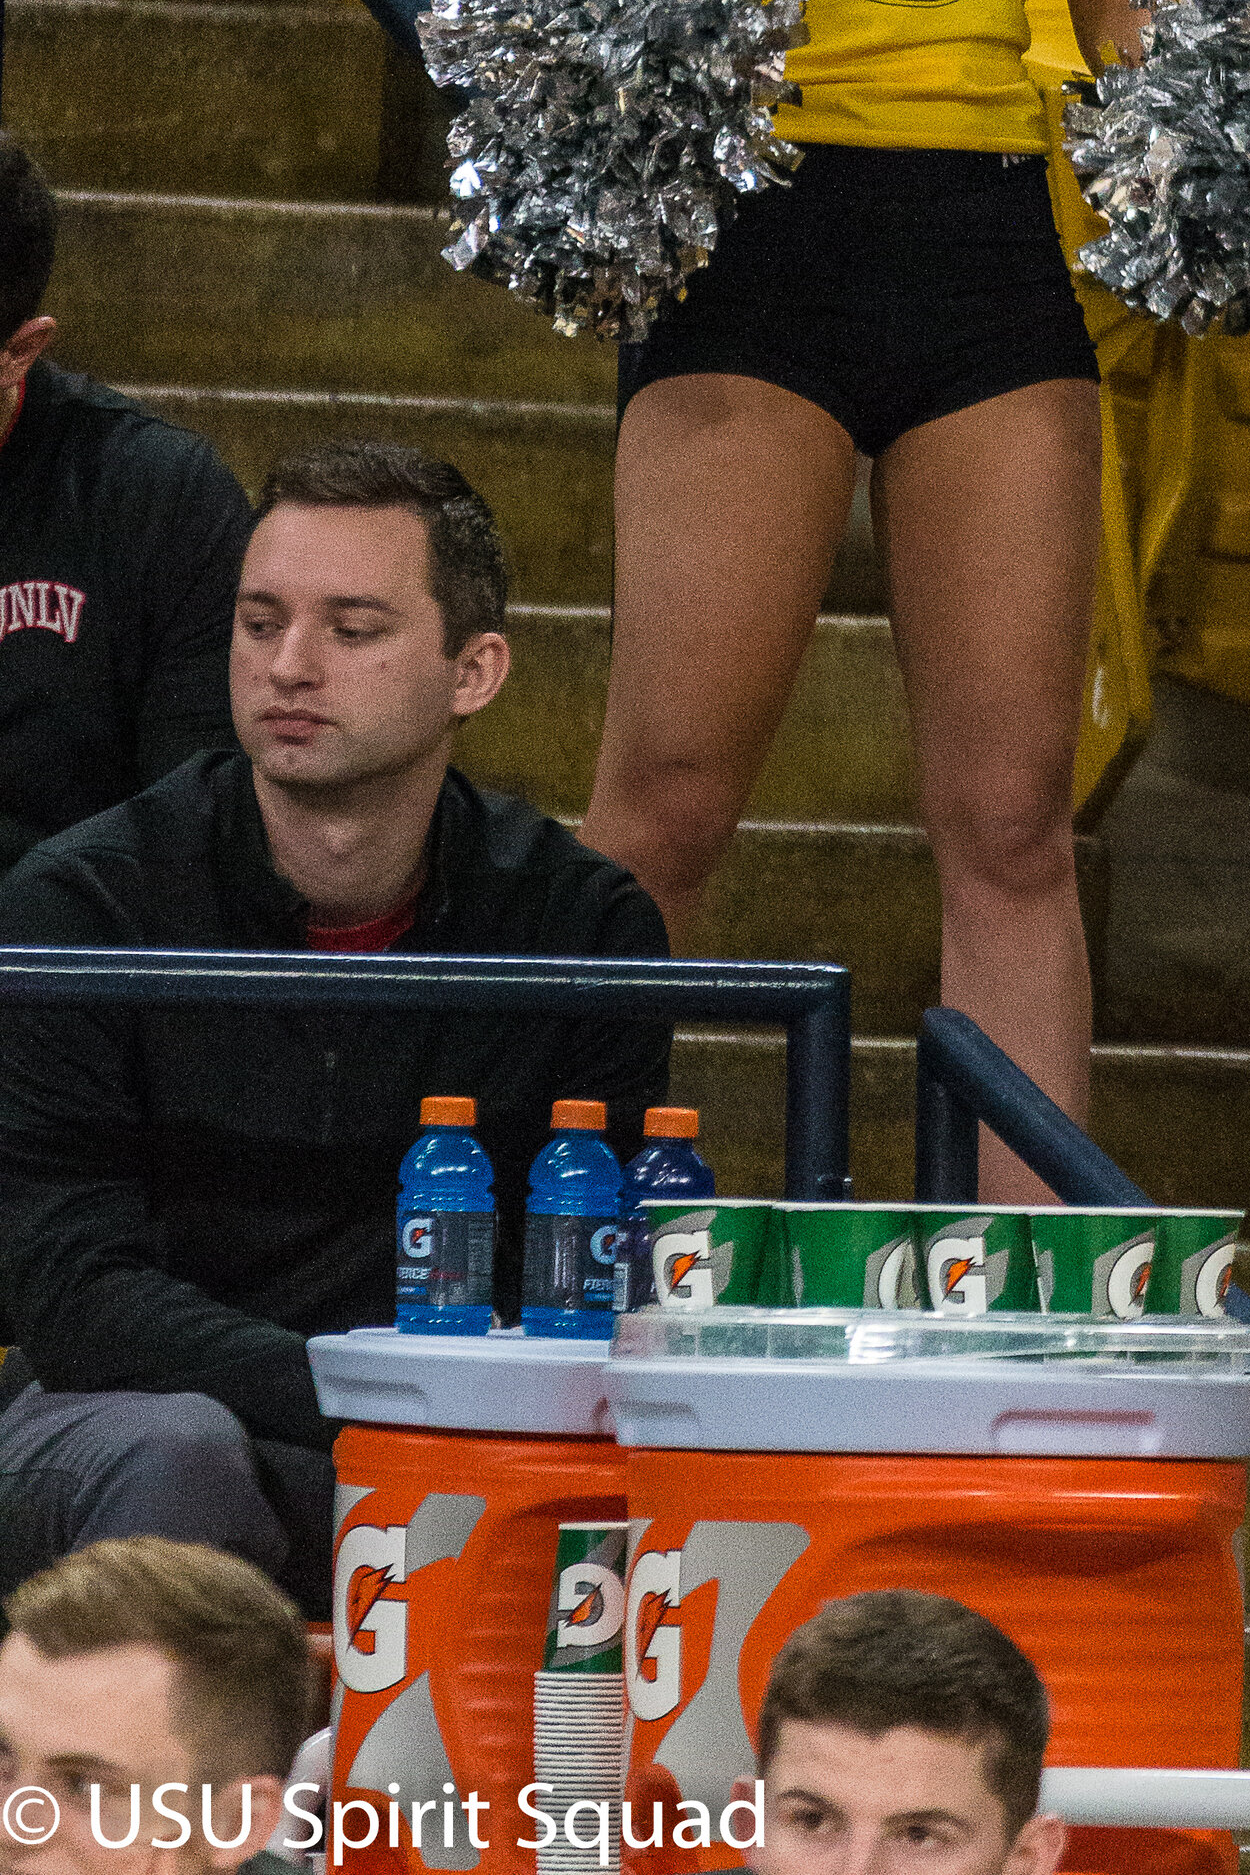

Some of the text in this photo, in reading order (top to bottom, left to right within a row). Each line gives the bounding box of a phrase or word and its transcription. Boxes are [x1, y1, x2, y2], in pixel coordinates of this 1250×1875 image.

[402, 1217, 434, 1259] G
[652, 1230, 715, 1309] G
[926, 1236, 987, 1316] G
[333, 1524, 408, 1694] G
[627, 1549, 683, 1722] G
